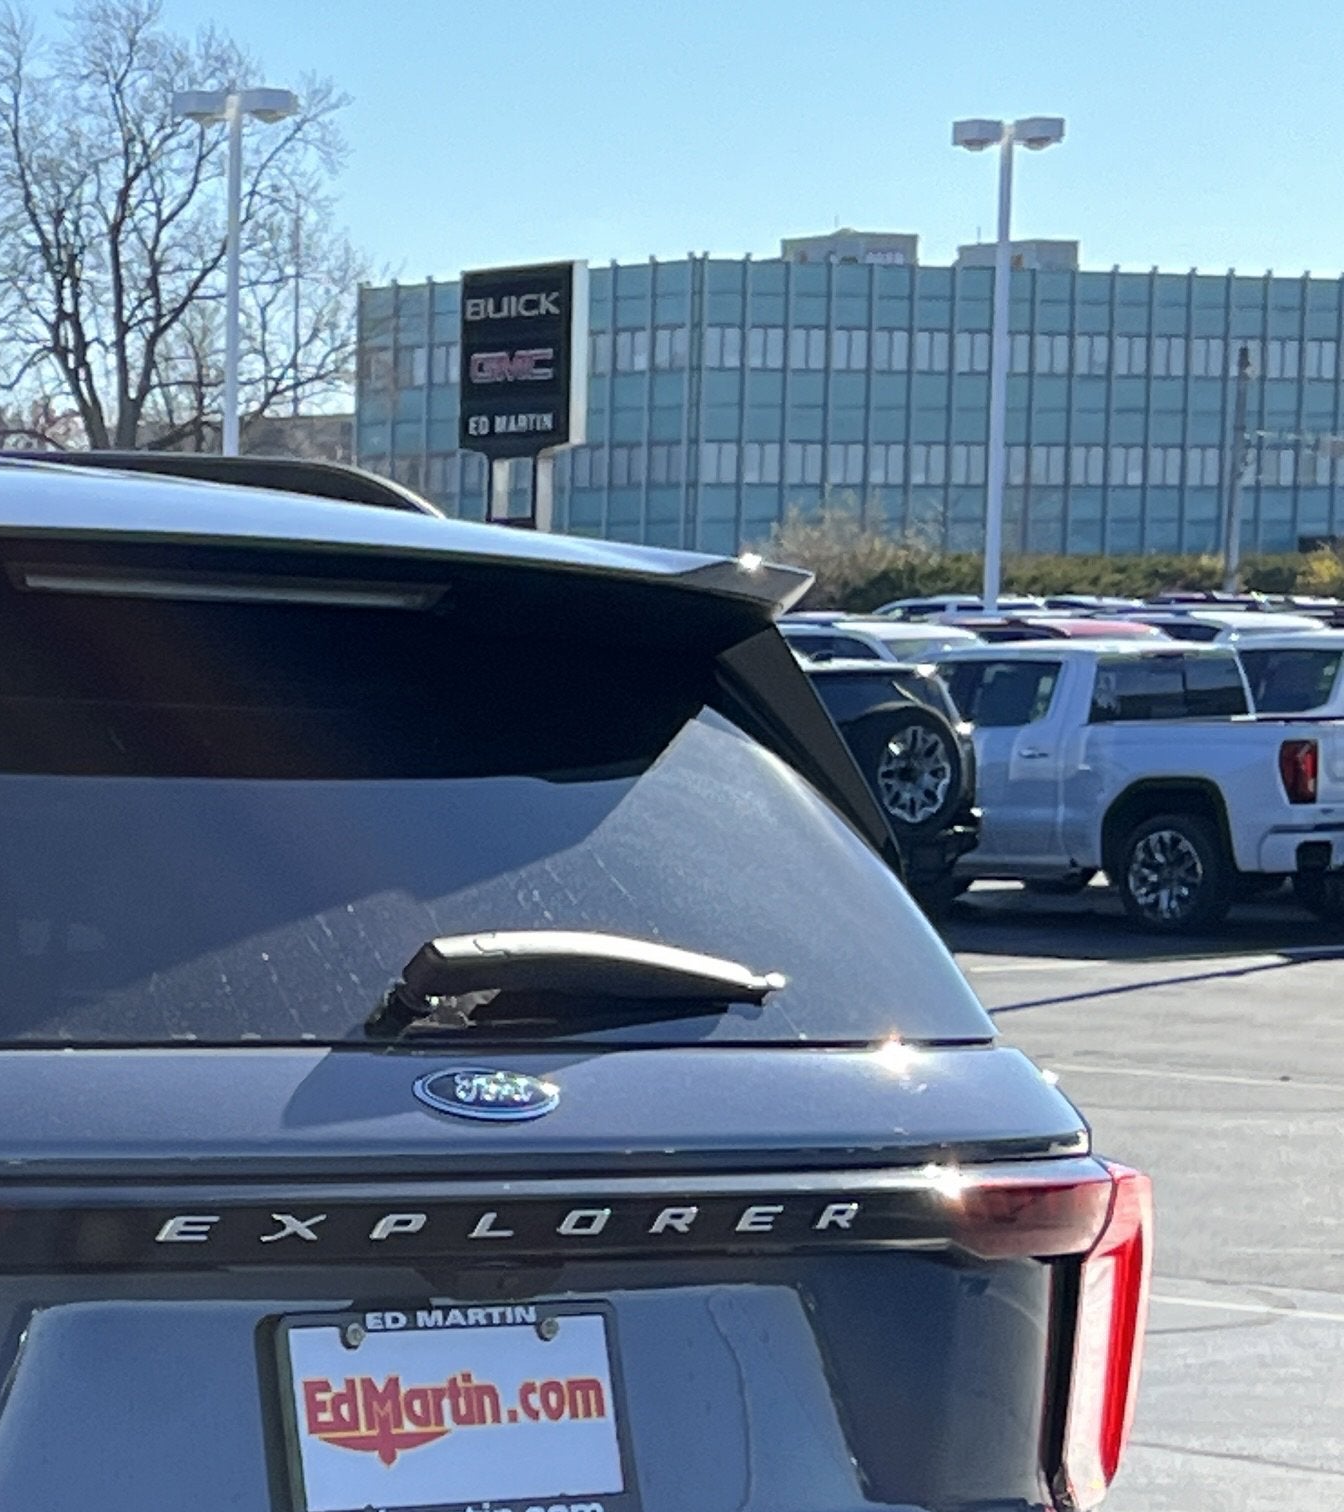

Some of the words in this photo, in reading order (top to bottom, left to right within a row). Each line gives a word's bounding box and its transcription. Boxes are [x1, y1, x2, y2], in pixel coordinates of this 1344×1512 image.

[465, 292, 560, 321] BUICK
[470, 348, 554, 383] GMC
[468, 415, 490, 436] ED
[494, 412, 553, 433] MARTIN
[155, 1202, 860, 1242] EXPLORER
[365, 1310, 408, 1331] ED
[416, 1305, 537, 1329] MARTIN
[302, 1370, 606, 1436] EdMartin.com
